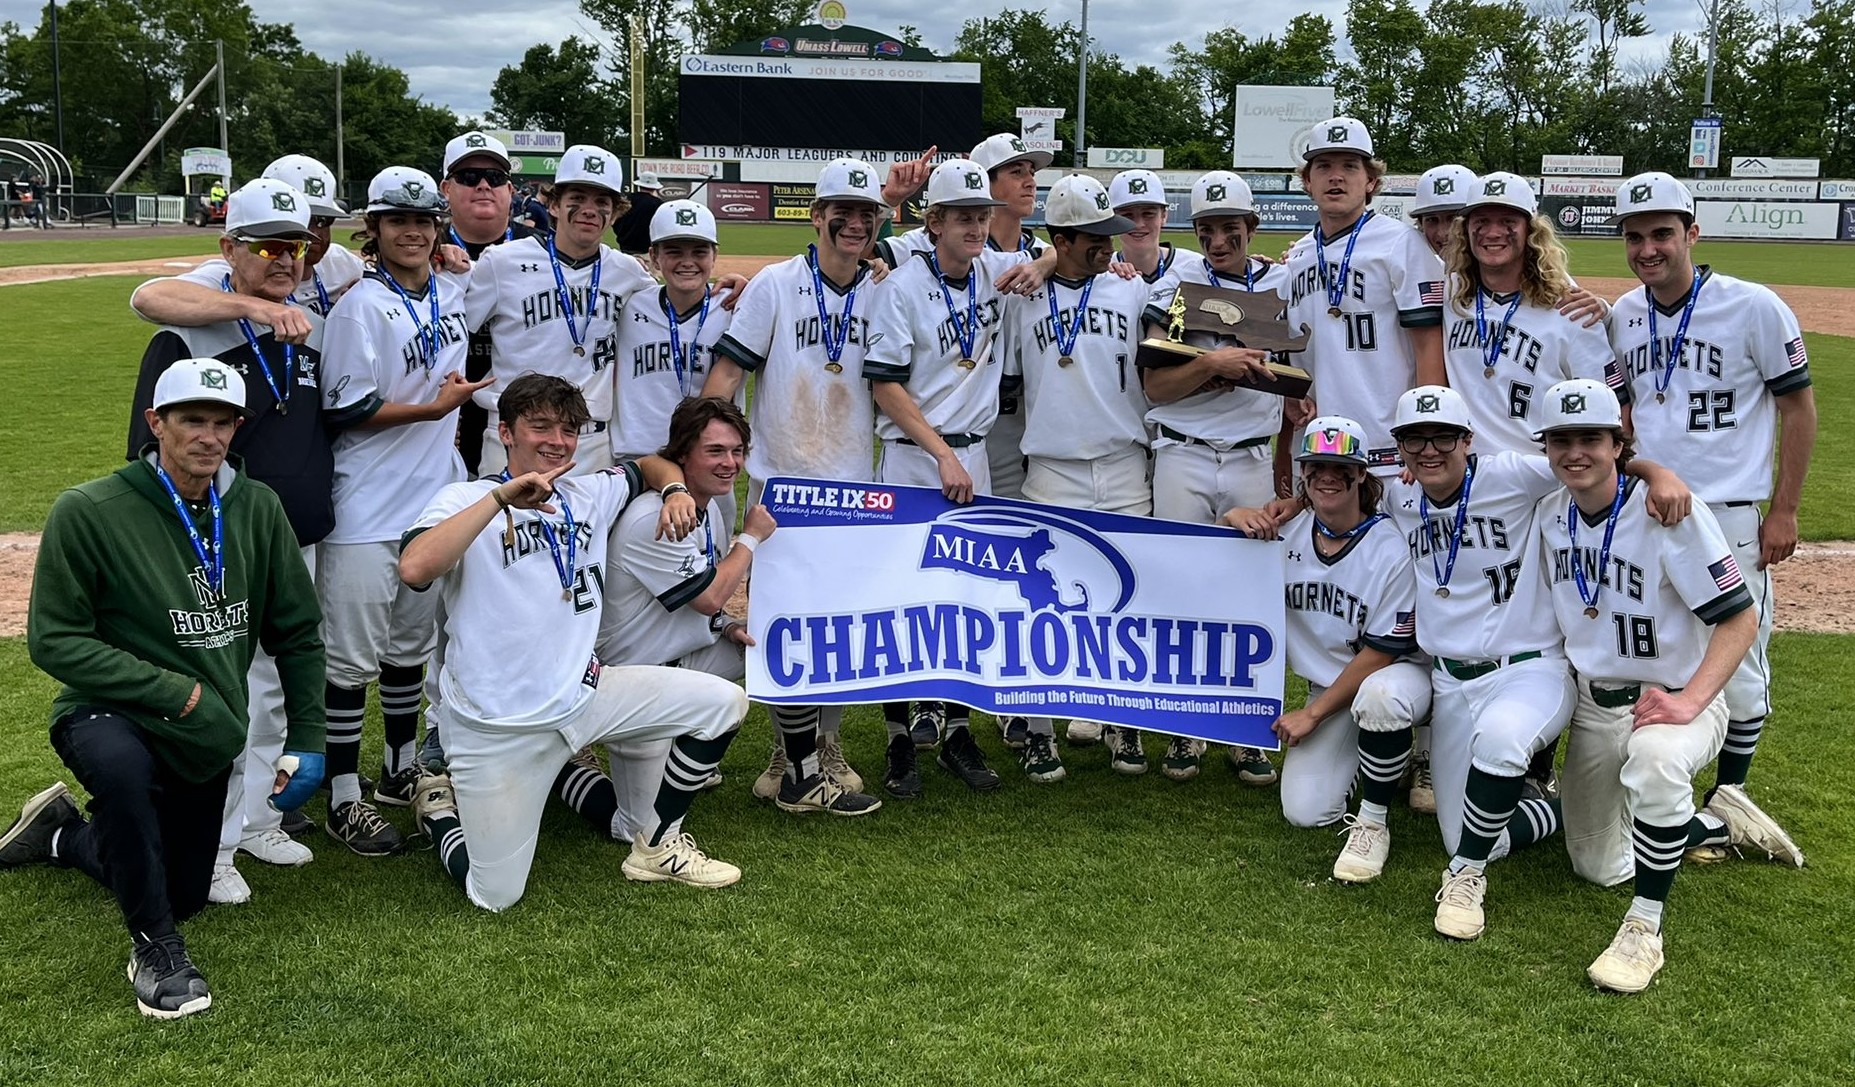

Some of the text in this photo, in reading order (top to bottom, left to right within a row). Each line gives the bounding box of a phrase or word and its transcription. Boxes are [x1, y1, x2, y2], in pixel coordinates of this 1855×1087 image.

[703, 61, 793, 75] Eastern Bank
[808, 67, 925, 78] JOIN US FOR GOOD
[1018, 108, 1063, 117] HAFFNER'S
[514, 134, 562, 147] GOT-JUNK?
[703, 146, 726, 158] 119
[733, 147, 780, 159] MAJOR
[788, 148, 853, 162] LEAGUERS
[861, 151, 887, 163] AND
[1105, 149, 1147, 164] DCU
[658, 163, 669, 174] THE
[773, 185, 791, 194] PETER
[1547, 184, 1618, 194] MARKET BASKE
[1696, 181, 1812, 193] Conference Center
[1839, 183, 1855, 193] Cro
[1271, 200, 1318, 210] difference
[1276, 211, 1300, 220] lives.
[1725, 203, 1805, 230] Align
[1342, 311, 1378, 352] 10
[1115, 353, 1128, 393] 1
[1508, 380, 1534, 421] 6
[1686, 388, 1738, 433] 22
[772, 484, 838, 509] TITLE
[865, 492, 894, 513] 50
[773, 504, 893, 521] Celebrating and Growing Opportunities
[1407, 515, 1510, 562] HORNETS
[932, 534, 1028, 574] MIAA
[571, 562, 606, 615] 21
[1612, 611, 1660, 660] 18
[766, 604, 1274, 688] CHAMPIONSHIP
[994, 690, 1275, 716] Building the Future Through Educational Athletics
